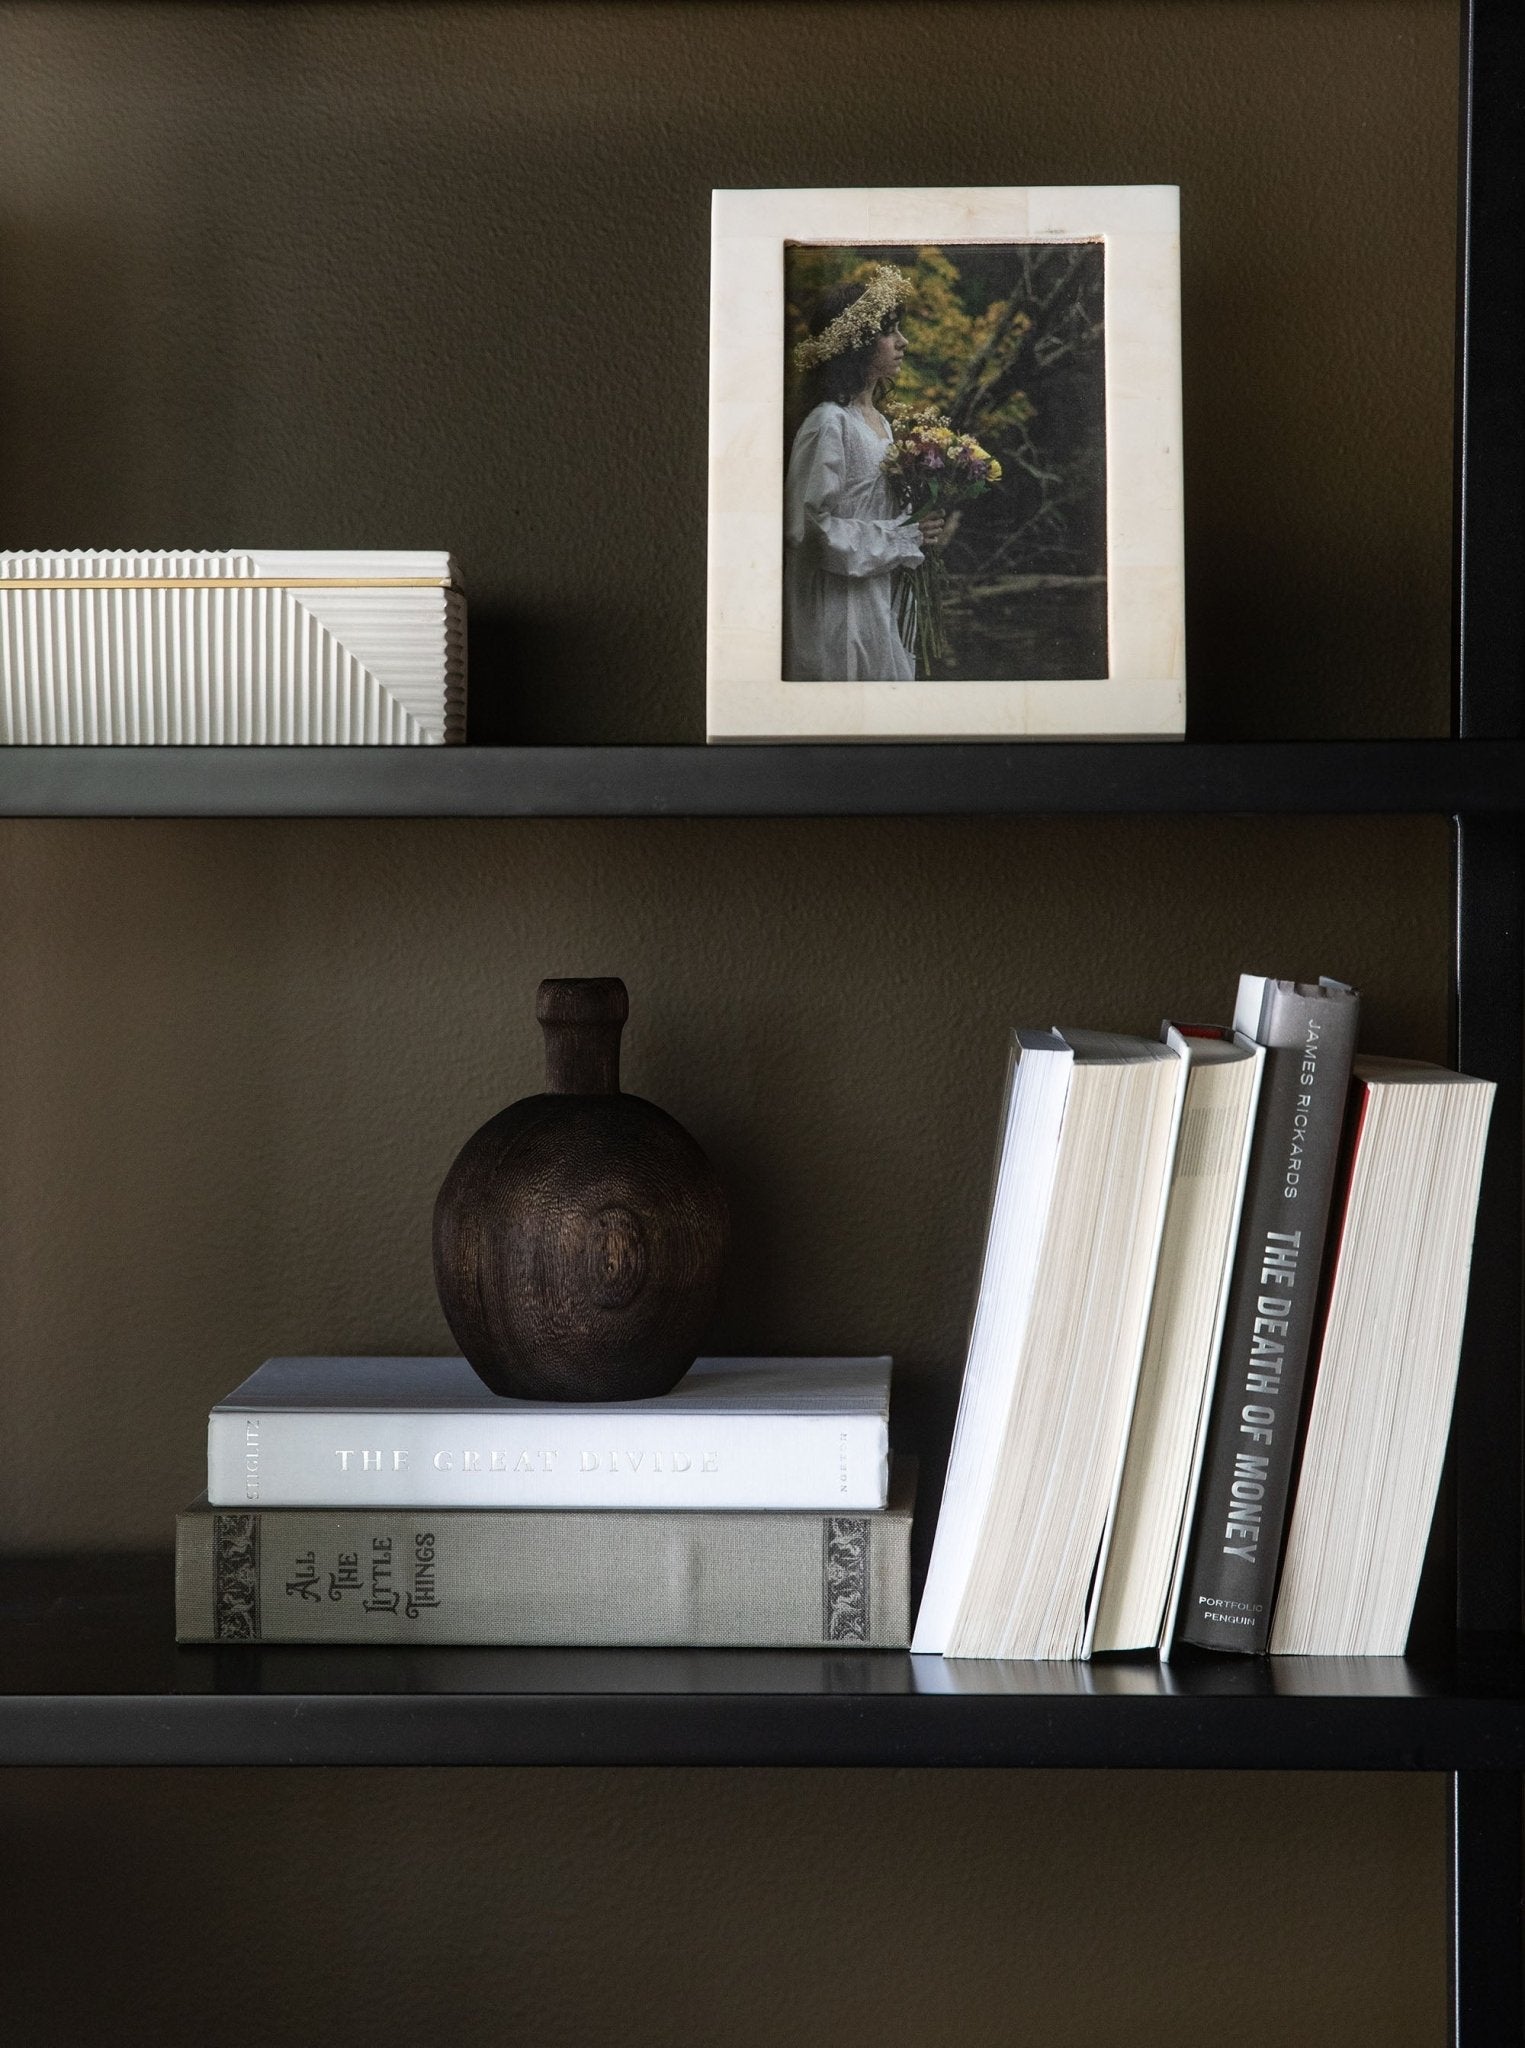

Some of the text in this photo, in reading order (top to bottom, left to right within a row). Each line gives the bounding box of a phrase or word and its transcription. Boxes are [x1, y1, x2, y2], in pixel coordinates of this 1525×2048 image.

[1284, 1018, 1321, 1199] JAMES RICKARDS
[1222, 1230, 1302, 1564] THE DEATH OF MONEY
[245, 1419, 261, 1501] STIGLITZ
[335, 1449, 720, 1474] THE GREAT DIVIDE
[1198, 1595, 1264, 1613] PORTFOLIO
[1203, 1611, 1256, 1627] PENGUIN
